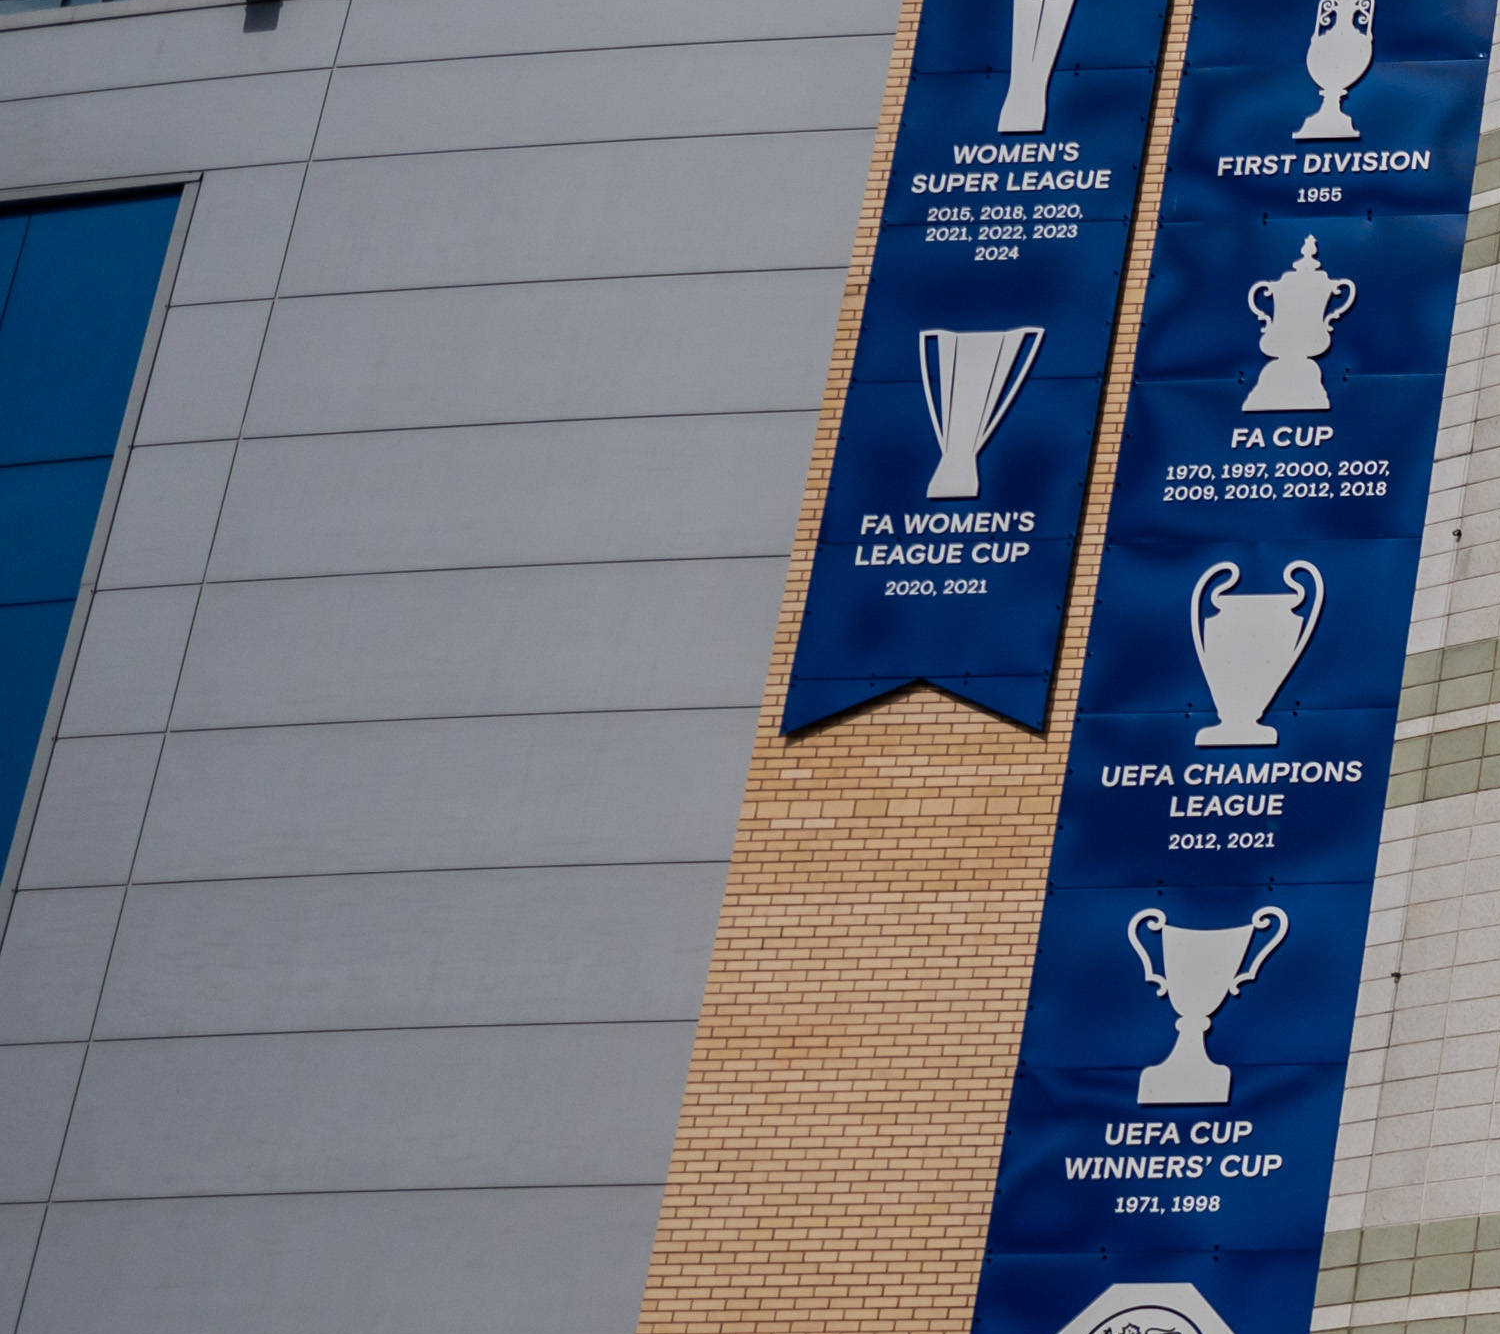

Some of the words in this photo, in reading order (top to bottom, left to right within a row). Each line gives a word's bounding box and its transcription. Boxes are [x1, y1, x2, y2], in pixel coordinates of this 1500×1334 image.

[954, 142, 1079, 164] WOMEN'S
[1218, 155, 1296, 176] FIRST
[1304, 151, 1430, 173] DIVISION
[912, 173, 999, 193] SUPER
[1007, 170, 1111, 190] LEAGUE
[1298, 188, 1341, 202] 1955
[928, 208, 974, 221] 2015,
[981, 206, 1027, 222] 2018,
[1033, 205, 1082, 218] 2020,
[926, 227, 972, 241] 2021,
[978, 226, 1026, 240] 2022,
[1033, 225, 1077, 238] 2023
[975, 247, 1018, 260] 2024
[1232, 428, 1265, 447] FA
[1273, 427, 1333, 446] CUP
[1167, 465, 1215, 480] 1970,
[1222, 463, 1268, 478] 1997,
[1275, 462, 1331, 477] 2000,
[1338, 461, 1389, 476] 2007,
[1164, 486, 1218, 501] 2009,
[1225, 484, 1276, 499] 2010,
[1283, 483, 1334, 498] 2012,
[1340, 482, 1386, 496] 2018
[861, 515, 893, 534] FA
[905, 512, 1035, 533] WOMEN'S
[855, 544, 963, 565] LEAGUE
[972, 543, 1029, 563] CUP
[885, 581, 936, 595] 2020,
[943, 580, 987, 594] 2021
[1102, 765, 1174, 787] UEFA
[1184, 761, 1362, 784] CHAMPIONS
[1170, 795, 1284, 816] LEAGUE
[1169, 834, 1221, 850] 2012,
[1228, 833, 1274, 848] 2021
[1105, 1123, 1180, 1145] UEFA
[1191, 1121, 1252, 1144] CUP
[1066, 1156, 1212, 1179] WINNERS’
[1220, 1155, 1282, 1177] CUP
[1115, 1197, 1165, 1214] 1971,
[1172, 1196, 1220, 1212] 1998
